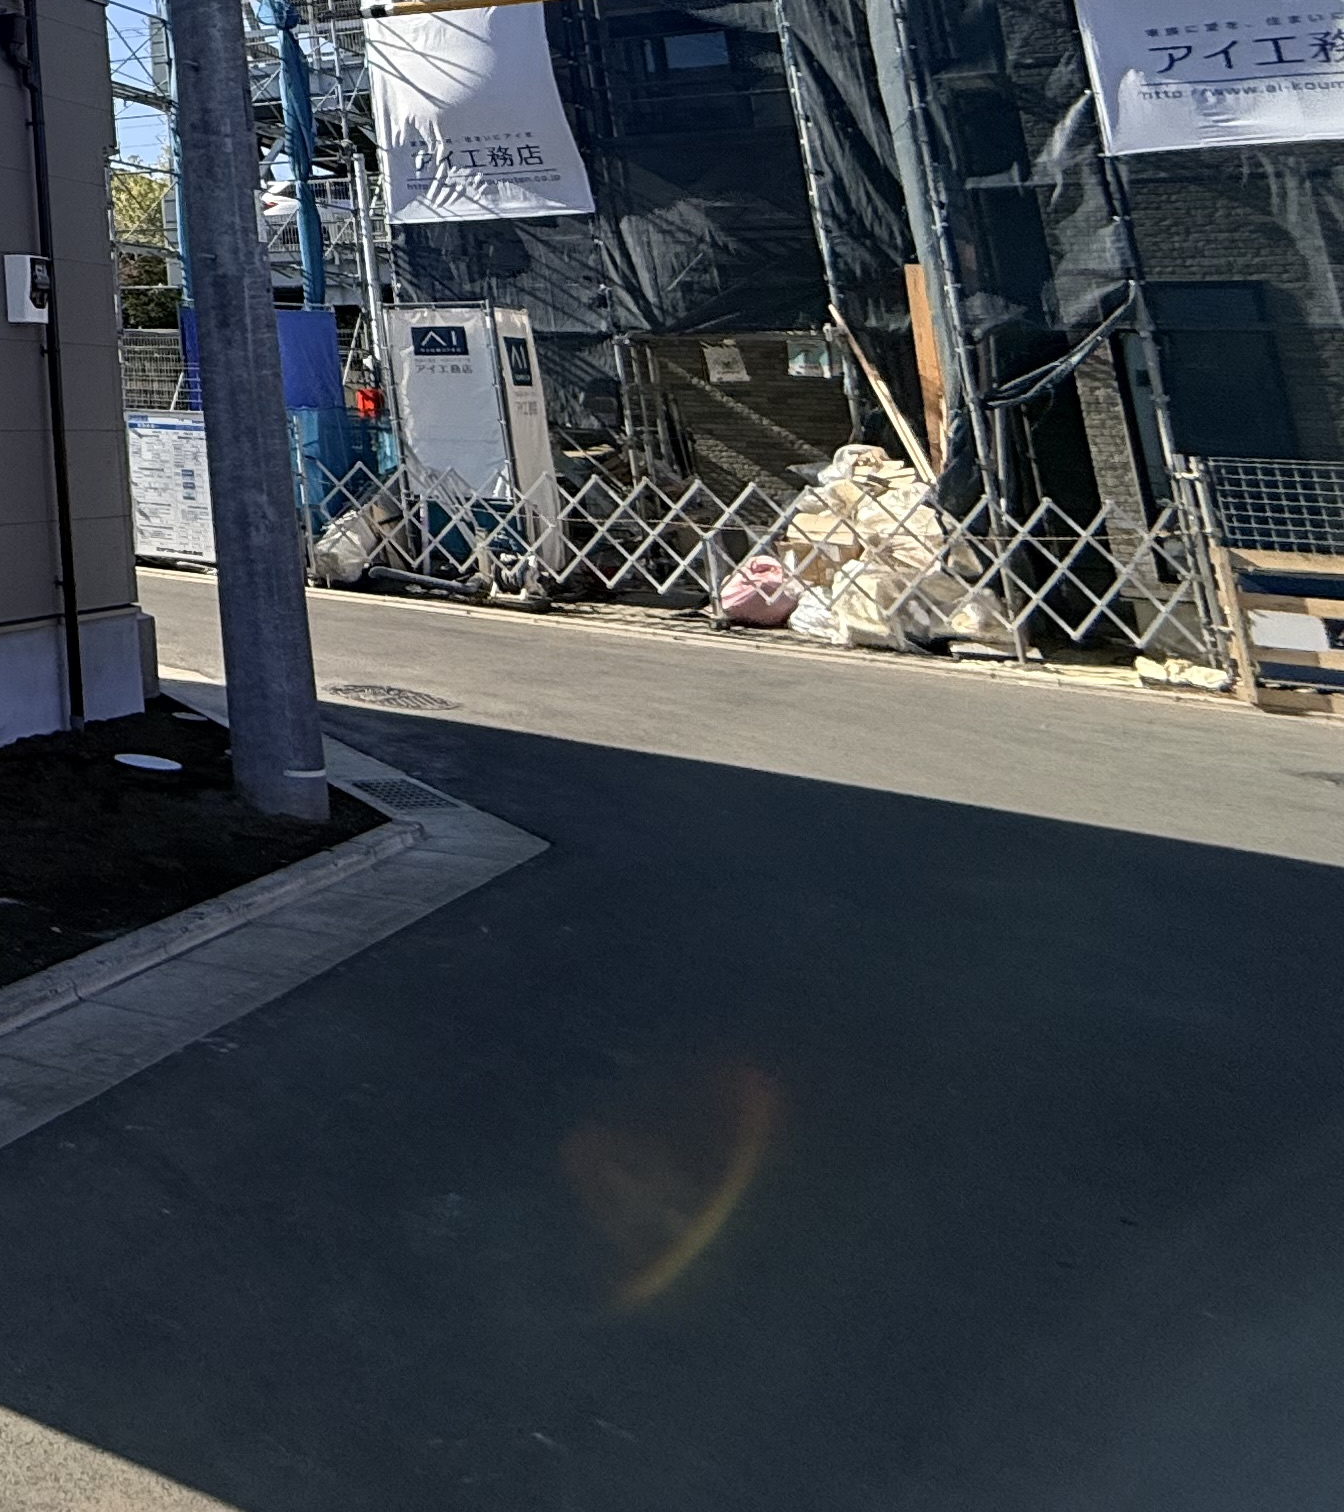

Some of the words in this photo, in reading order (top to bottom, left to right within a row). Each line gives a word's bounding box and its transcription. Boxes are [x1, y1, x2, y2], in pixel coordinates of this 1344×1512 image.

[411, 144, 543, 171] アイ工務店
